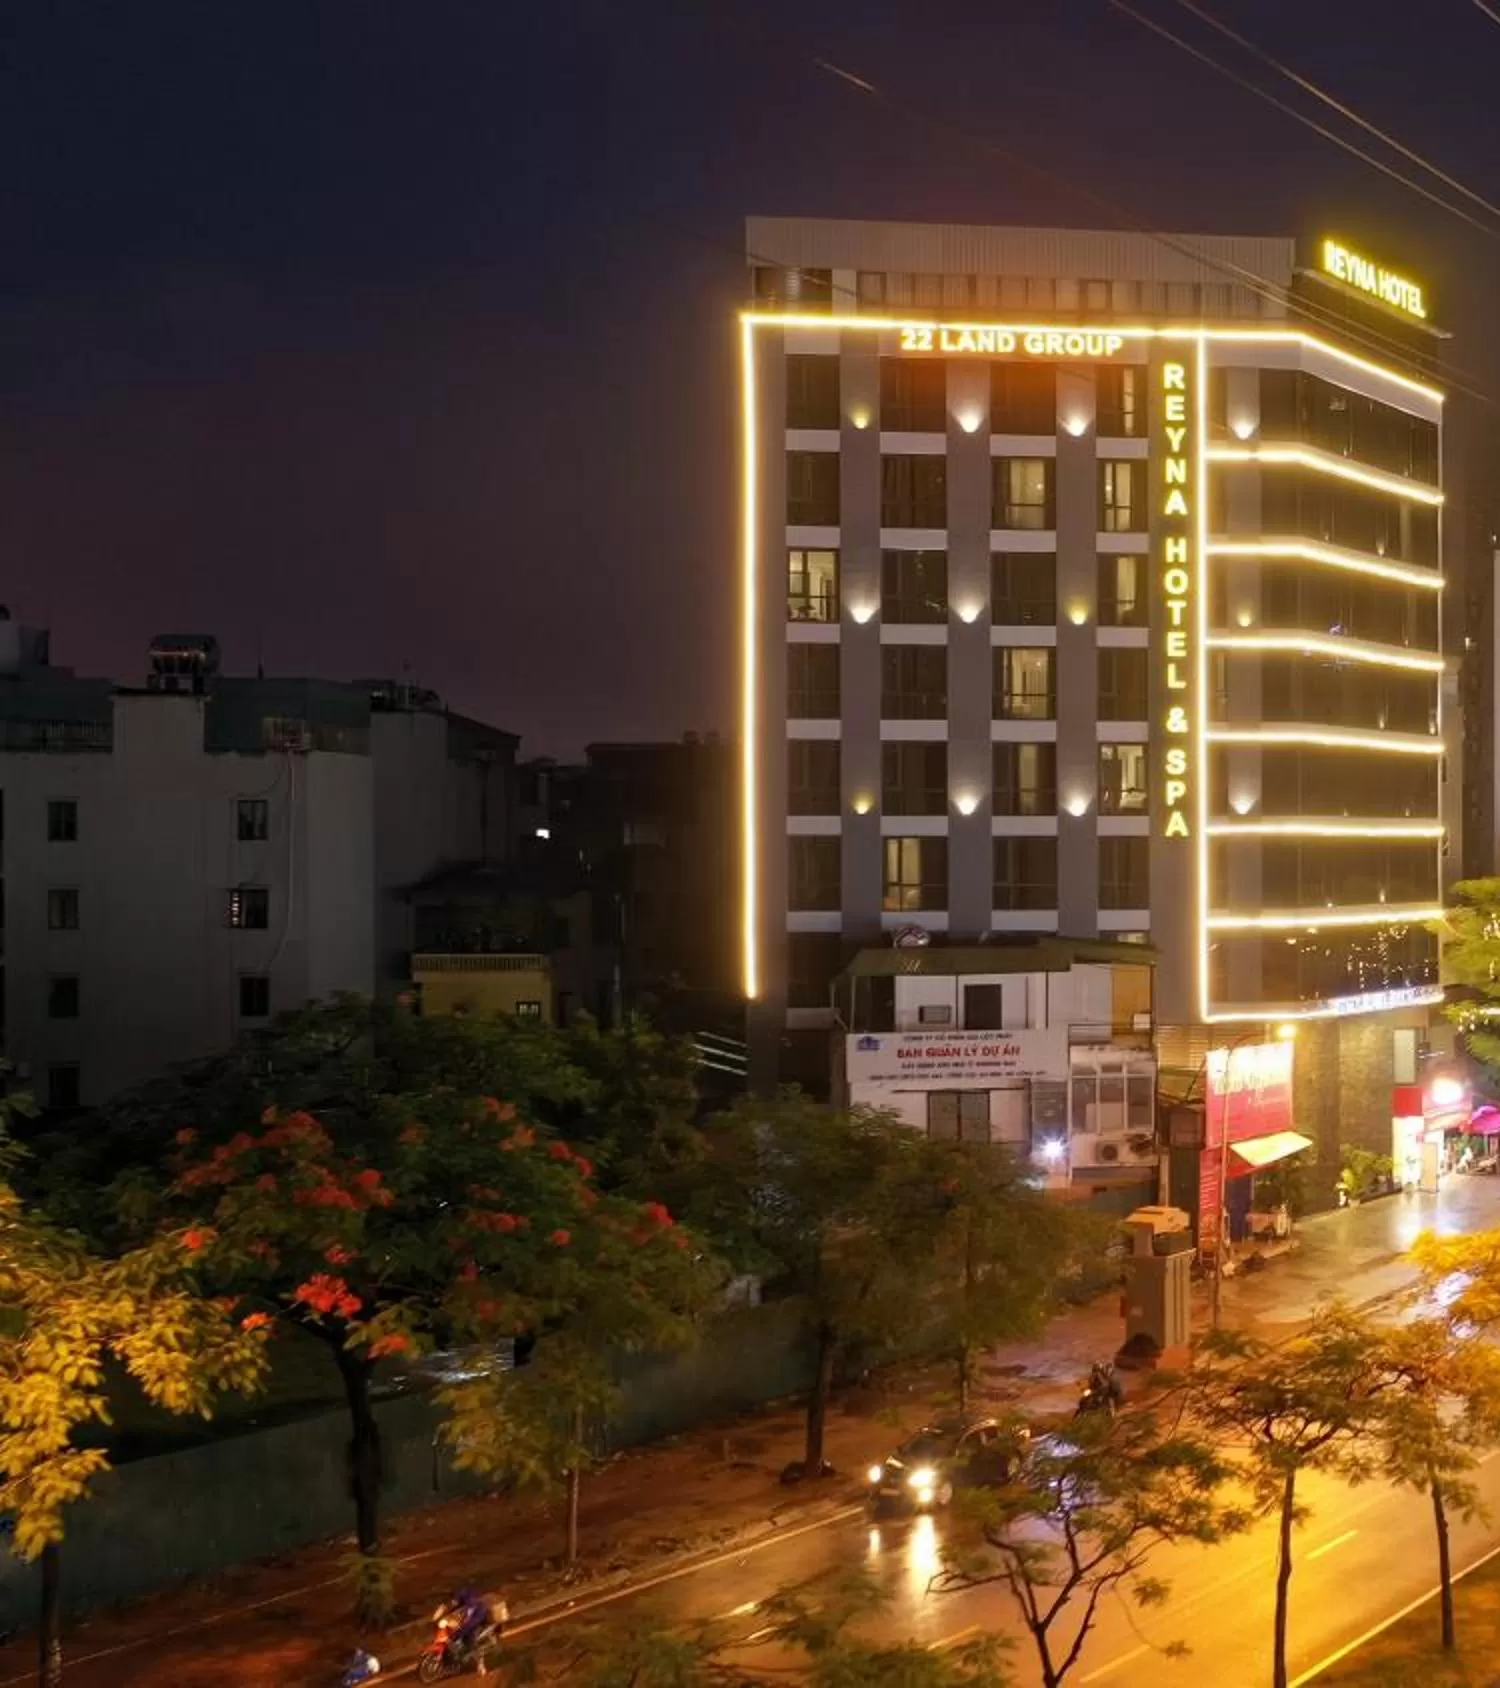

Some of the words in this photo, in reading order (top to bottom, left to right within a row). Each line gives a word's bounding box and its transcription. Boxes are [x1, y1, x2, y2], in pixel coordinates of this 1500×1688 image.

[1378, 268, 1426, 318] HOTEL
[901, 328, 933, 351] 22
[940, 328, 1016, 353] LAND
[1024, 334, 1123, 357] GROUP
[1163, 363, 1188, 515] REYNA
[1164, 537, 1188, 688] HOTEL
[1166, 706, 1188, 733] &
[1165, 749, 1188, 836] SPA
